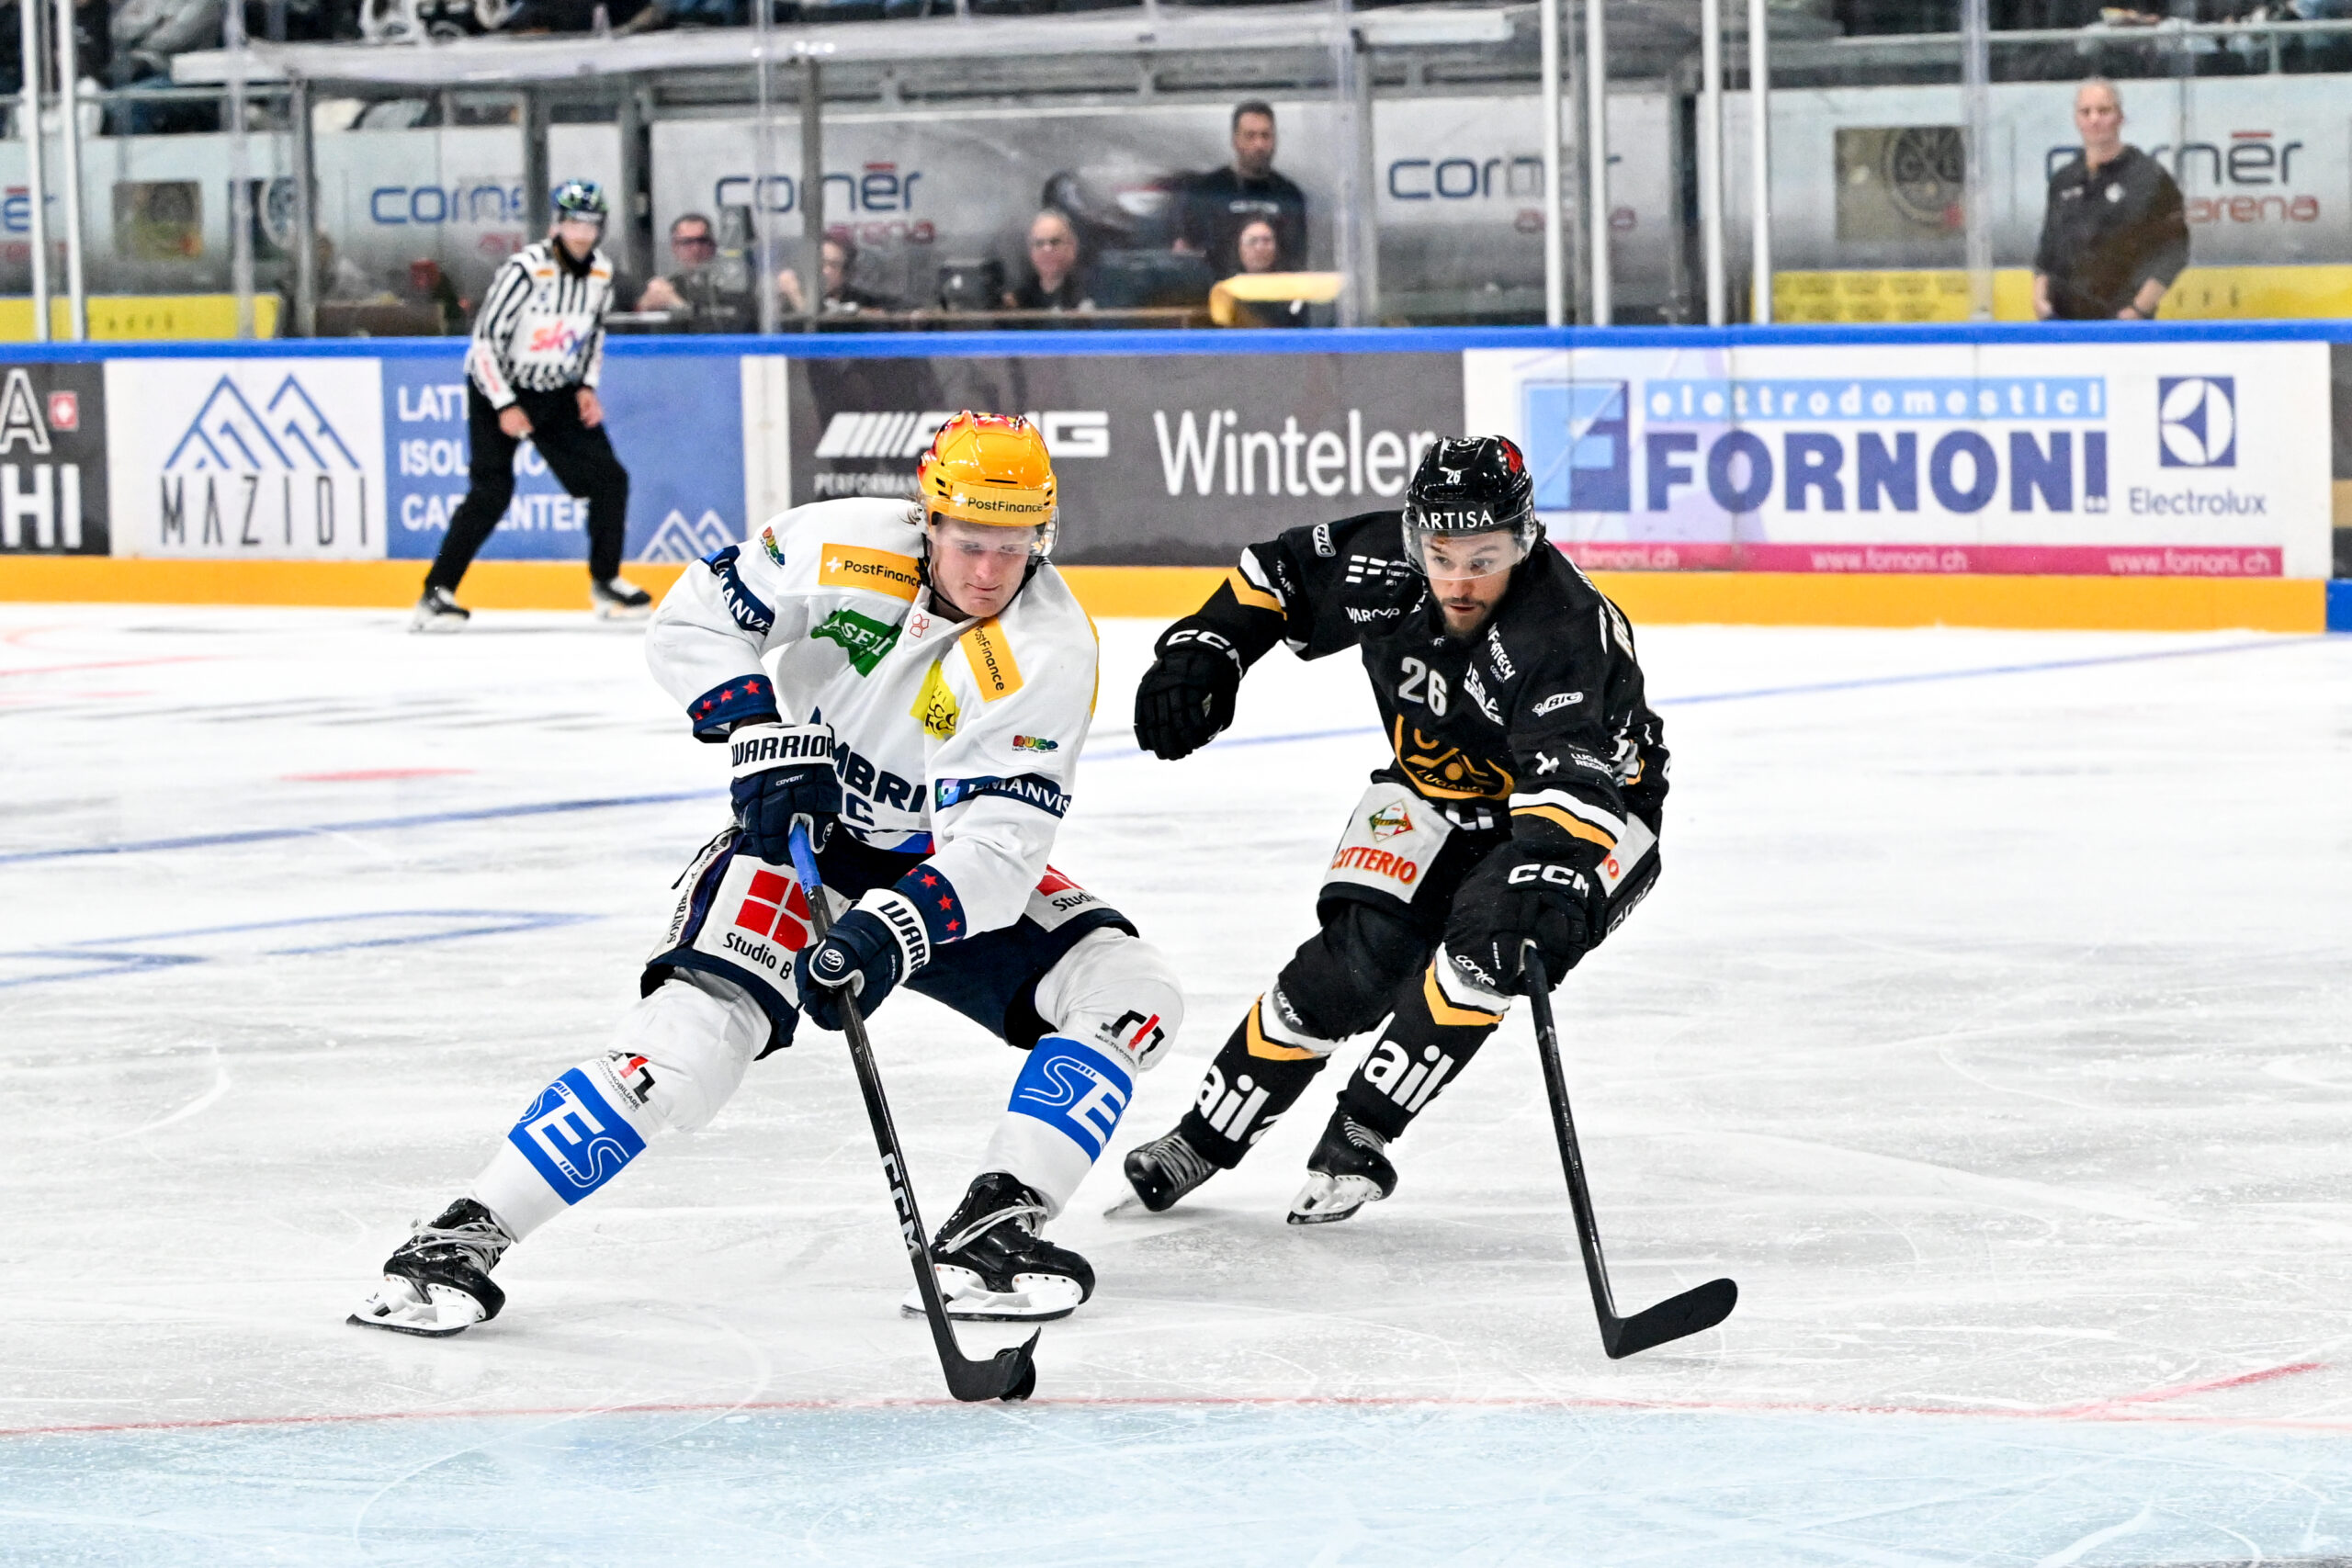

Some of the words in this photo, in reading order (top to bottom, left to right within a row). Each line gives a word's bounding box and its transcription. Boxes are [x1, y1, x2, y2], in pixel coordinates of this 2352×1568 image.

[1650, 383, 2101, 416] elettrodomestici
[1154, 409, 1436, 497] Winteler
[1645, 429, 2109, 514] FORNONI
[1445, 470, 1462, 485] 26
[967, 496, 1044, 513] PostFinance
[1418, 509, 1495, 529] ARTISA
[2128, 487, 2268, 517] Electrolux
[843, 559, 922, 589] PostFinance
[974, 625, 1006, 692] PostFinance
[1397, 656, 1448, 717] 26
[1548, 693, 1580, 708] BIC
[731, 734, 837, 768] WARRIOR
[808, 705, 928, 813] MBRI
[1331, 845, 1419, 886] CITTERIO
[1507, 863, 1590, 898] CCM
[722, 931, 777, 970] Studio
[778, 960, 793, 981] B
[1363, 1039, 1455, 1114] ail
[881, 1152, 922, 1260] CCM
